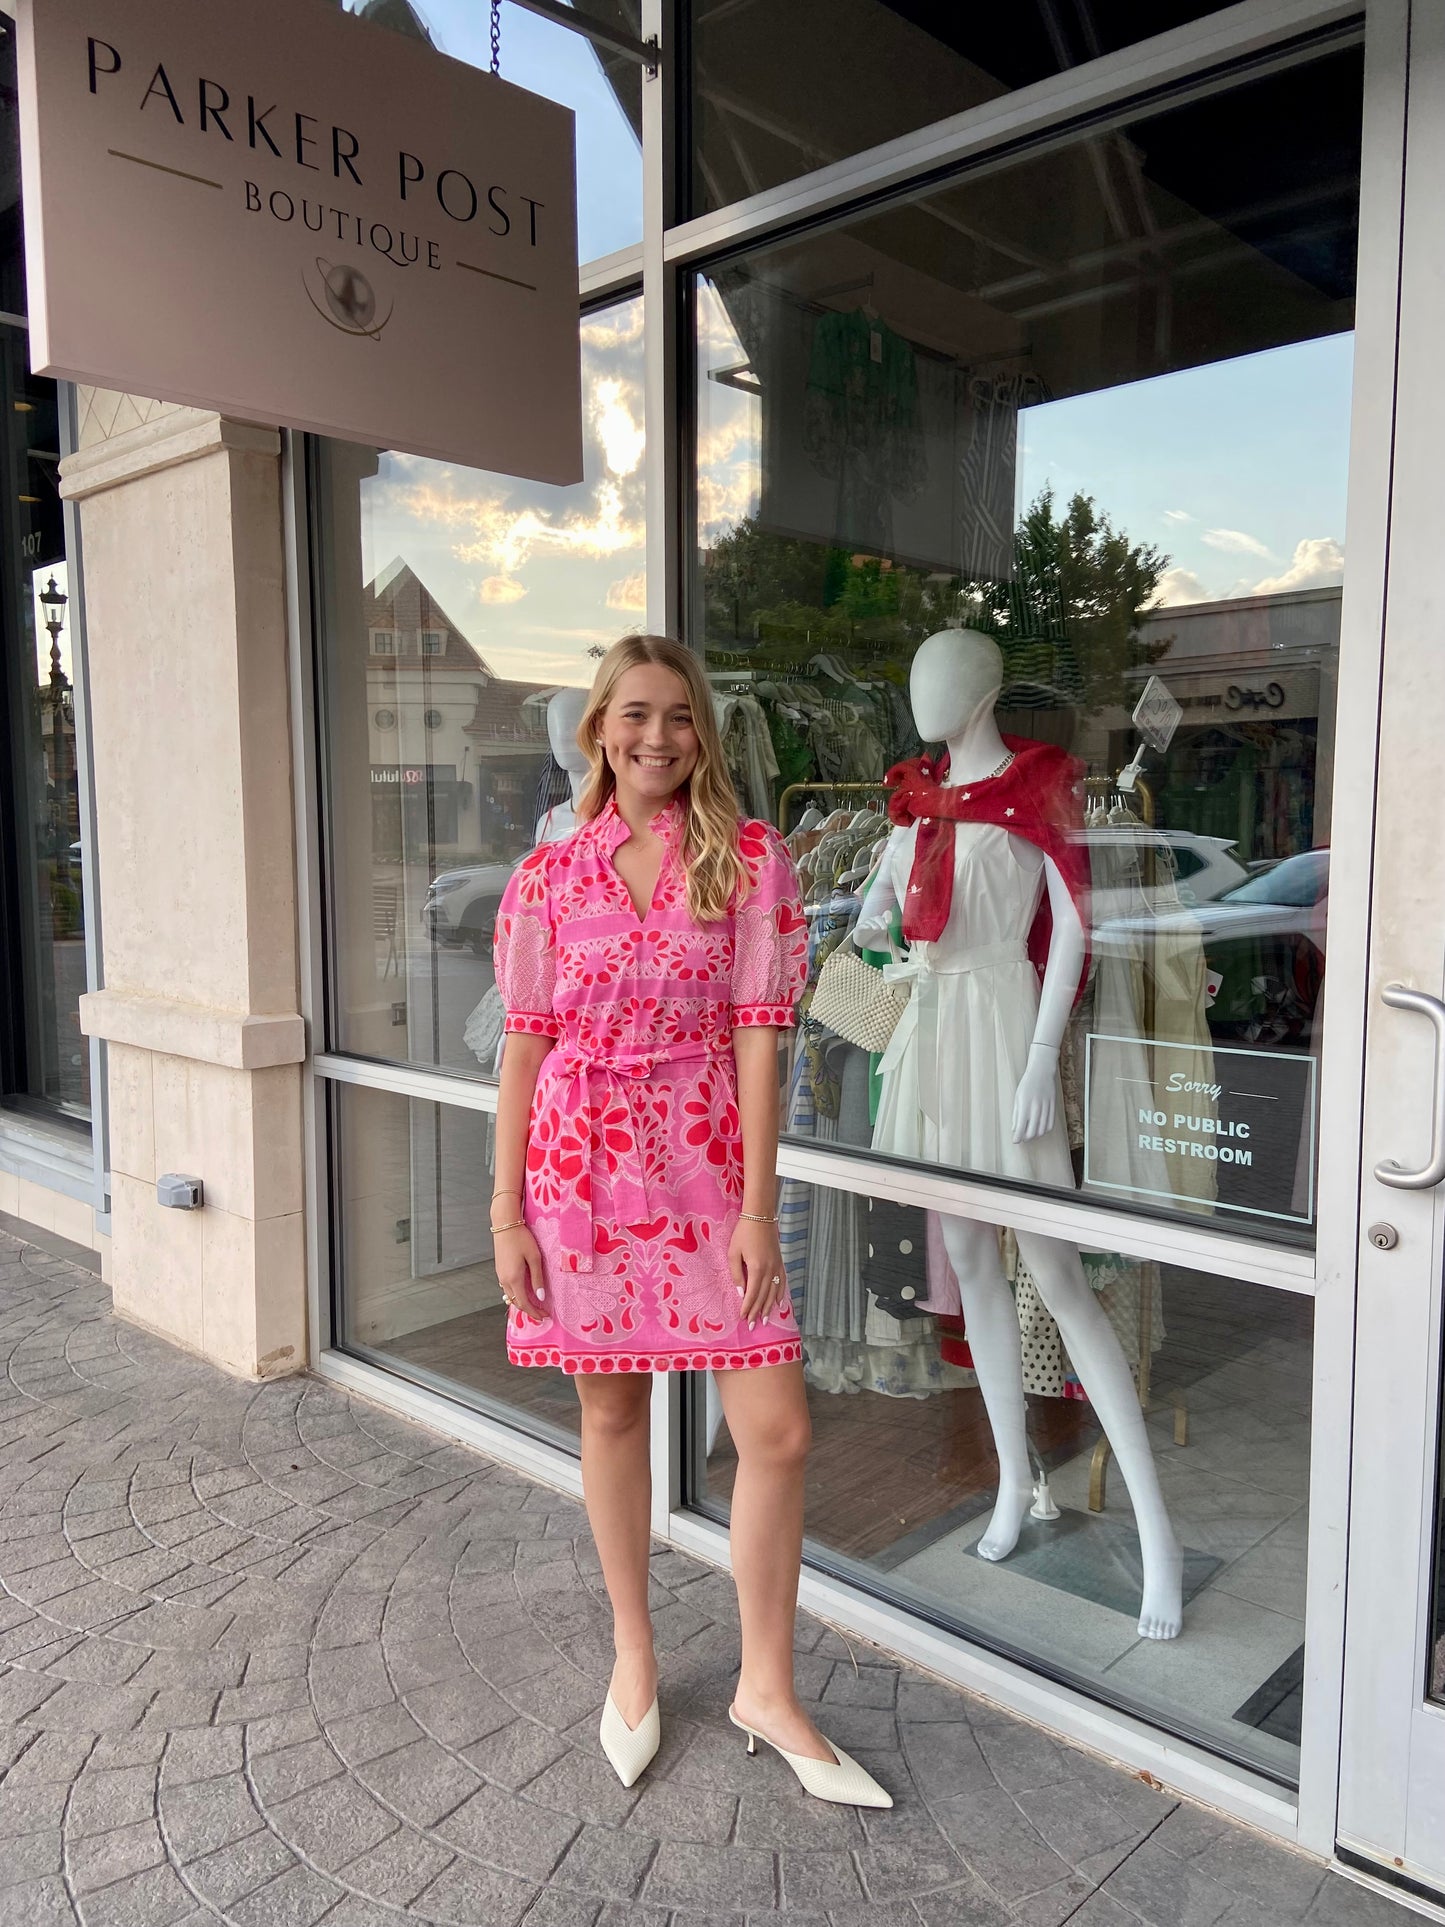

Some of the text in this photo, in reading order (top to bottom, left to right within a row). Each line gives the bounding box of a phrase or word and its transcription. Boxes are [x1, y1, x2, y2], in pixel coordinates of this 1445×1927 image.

[87, 36, 545, 247] PARKER POST
[243, 180, 442, 270] BOUTIQUE
[21, 530, 42, 557] 107
[1164, 1072, 1222, 1102] Sorry
[1138, 1108, 1251, 1139] NO PUBLIC
[1138, 1134, 1253, 1166] RESTROOM
